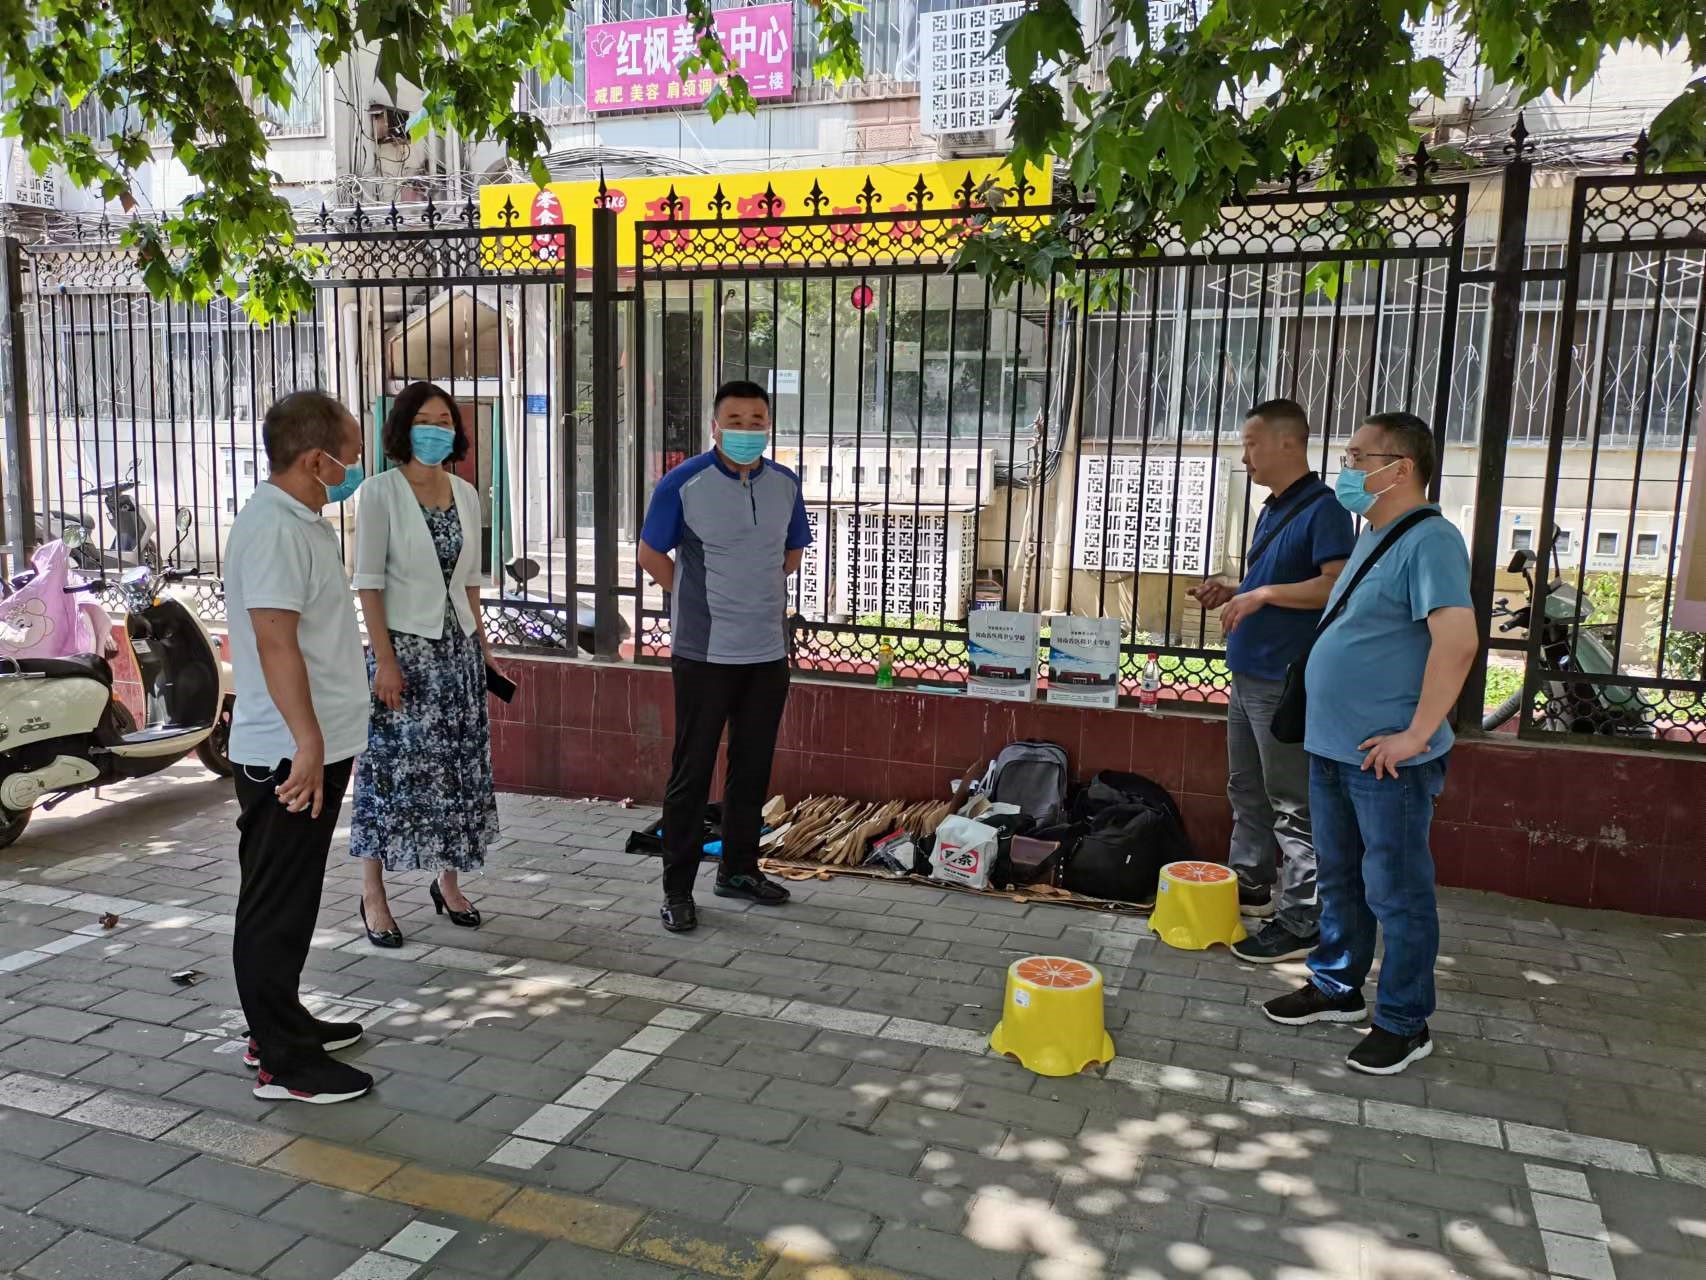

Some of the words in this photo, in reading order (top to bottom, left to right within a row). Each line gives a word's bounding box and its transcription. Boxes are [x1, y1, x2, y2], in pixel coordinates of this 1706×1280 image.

[615, 15, 789, 77] 红枫养中心
[594, 85, 624, 105] 减肥
[630, 82, 660, 102] 美容
